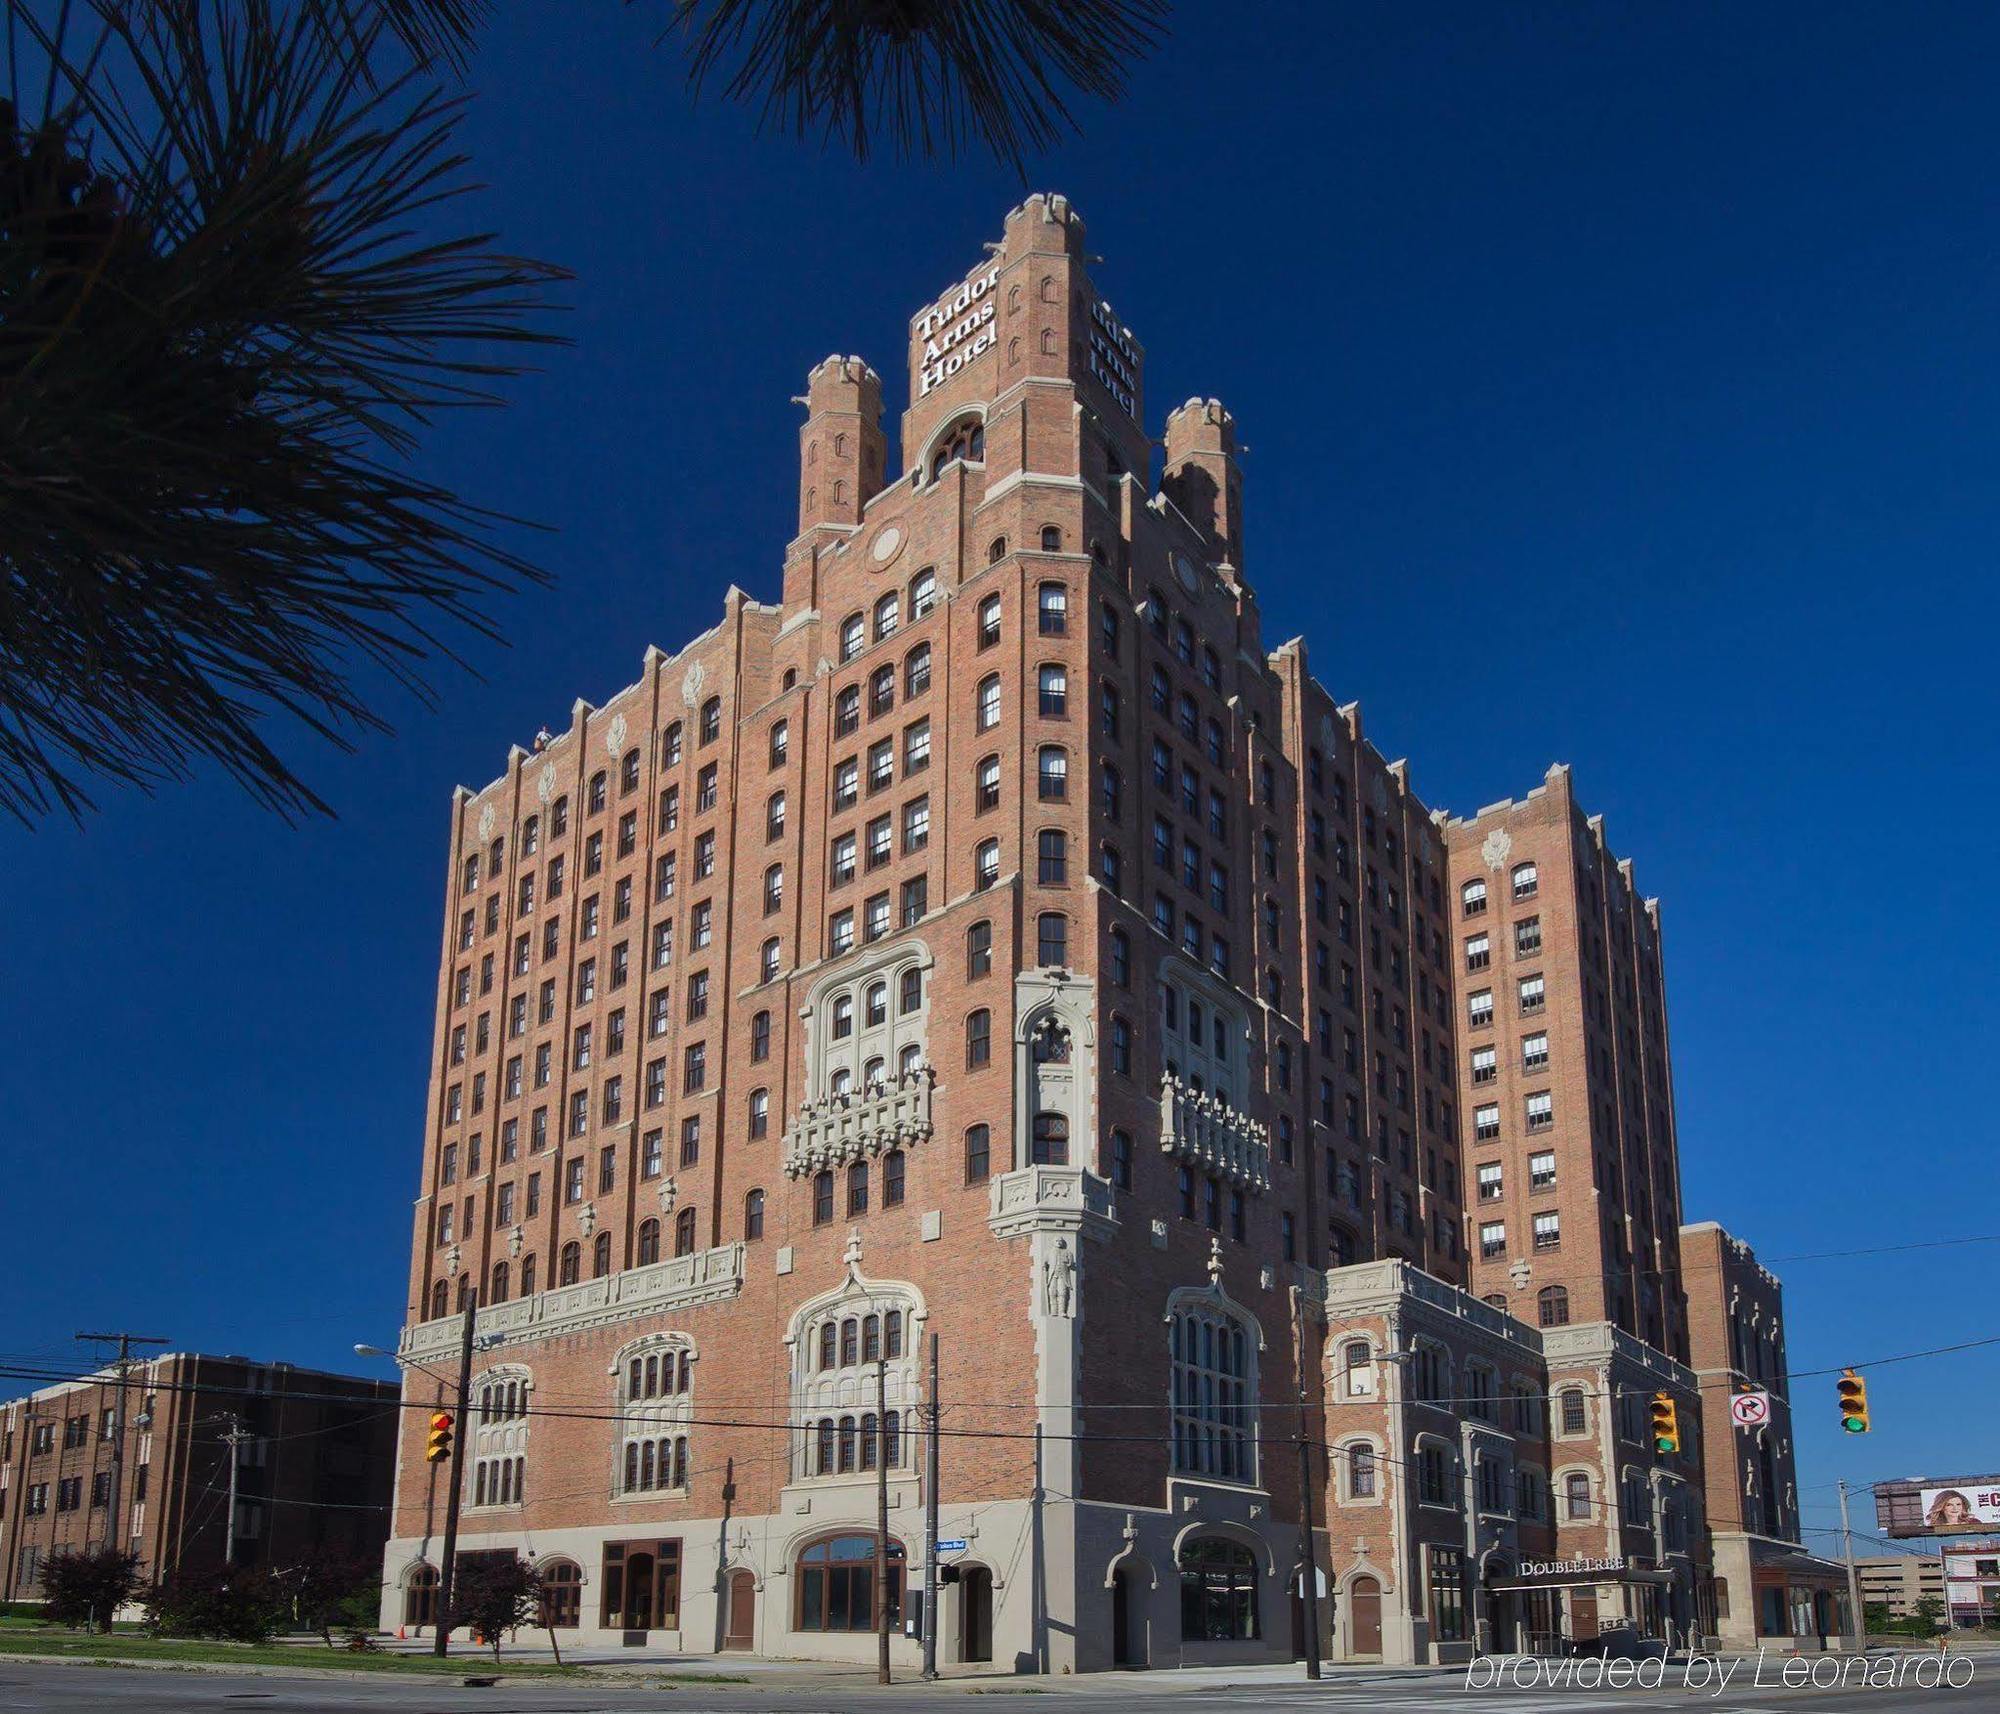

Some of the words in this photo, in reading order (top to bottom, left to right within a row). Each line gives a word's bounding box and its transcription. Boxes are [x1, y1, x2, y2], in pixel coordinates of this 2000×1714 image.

[916, 266, 1000, 340] Tudor
[921, 301, 994, 368] Arms
[919, 319, 997, 397] Hotel
